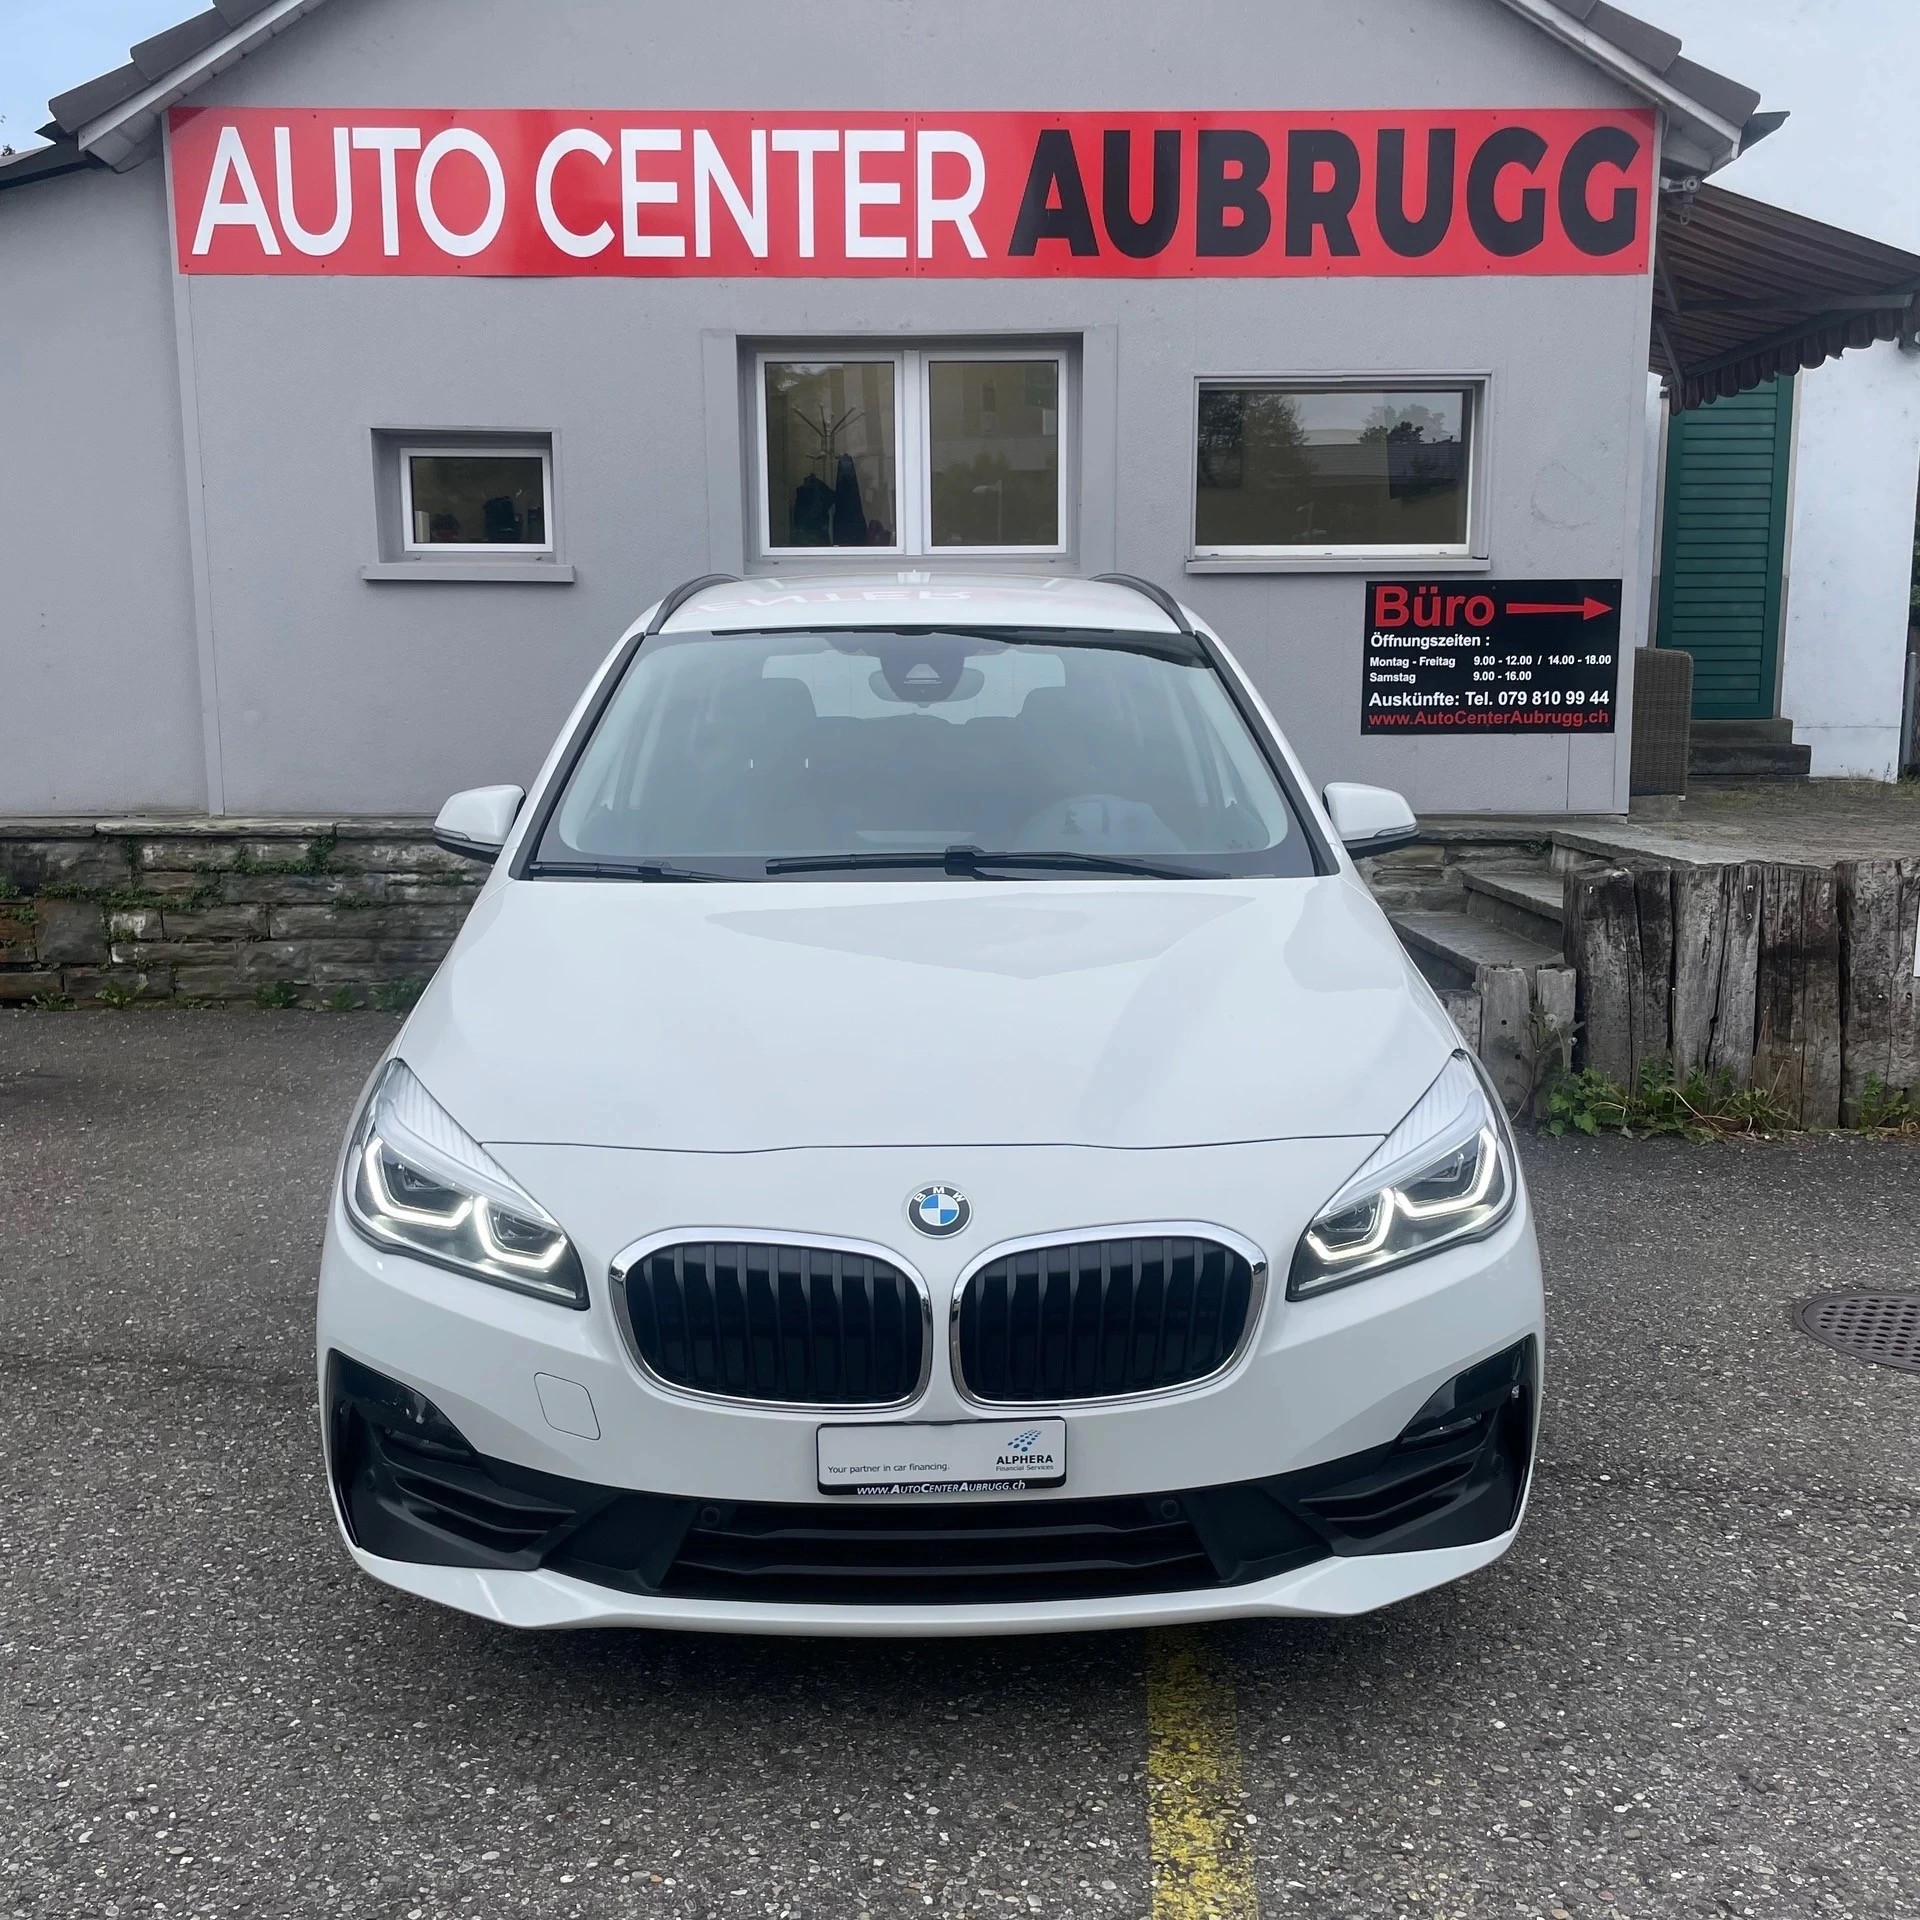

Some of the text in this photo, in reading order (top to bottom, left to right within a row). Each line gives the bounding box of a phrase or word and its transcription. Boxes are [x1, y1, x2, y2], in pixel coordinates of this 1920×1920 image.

[191, 125, 1641, 260] AUTO CENTER AUBRUGG
[1374, 585, 1495, 628] Büro
[1370, 632, 1481, 650] Öffnungszeiten
[1369, 656, 1410, 668] Montag
[1419, 656, 1456, 668] Freitag
[1473, 655, 1495, 666] 9.00
[1505, 655, 1532, 666] 12.00
[1548, 655, 1575, 665] 14.00
[1584, 654, 1612, 665] 18.00
[1369, 672, 1416, 684] Samstag
[1472, 671, 1495, 681] 9.00
[1504, 670, 1532, 681] 16.00
[1368, 690, 1609, 708] Auskünfte: Tel. 079 810 99 44
[1368, 709, 1609, 728] www.AutoCenterAubrugg.ch
[913, 1186, 966, 1202] BMW
[996, 1454, 1054, 1465] ALPHERA
[827, 1462, 950, 1475] Your partner in car financing.
[995, 1464, 1025, 1472] Financial
